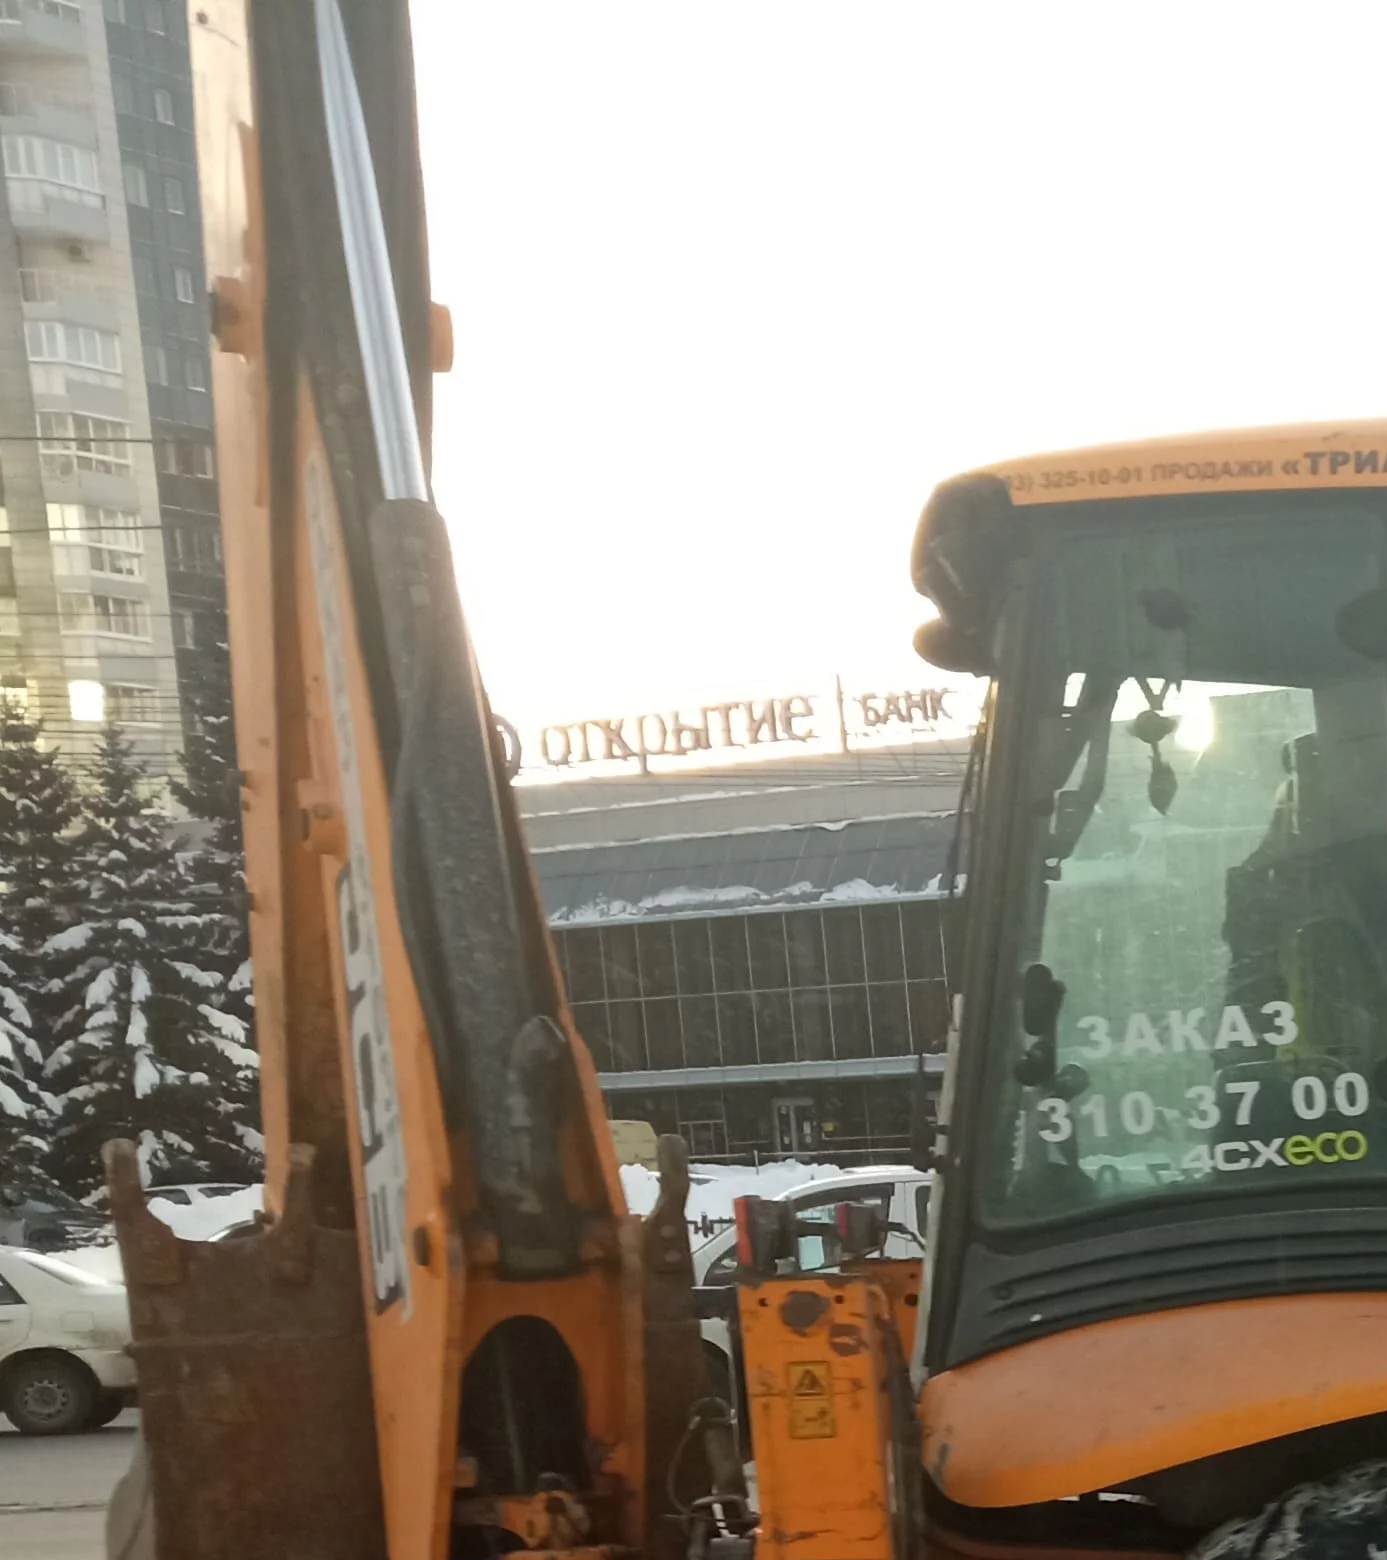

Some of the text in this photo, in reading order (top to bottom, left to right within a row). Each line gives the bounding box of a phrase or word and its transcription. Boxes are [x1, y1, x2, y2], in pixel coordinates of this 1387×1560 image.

[1151, 459, 1273, 483] ПРОДАЖИ
[860, 687, 955, 727] БАНК
[1076, 1000, 1299, 1060] ЗАКАЗ
[1037, 1071, 1370, 1142] 310 37 00
